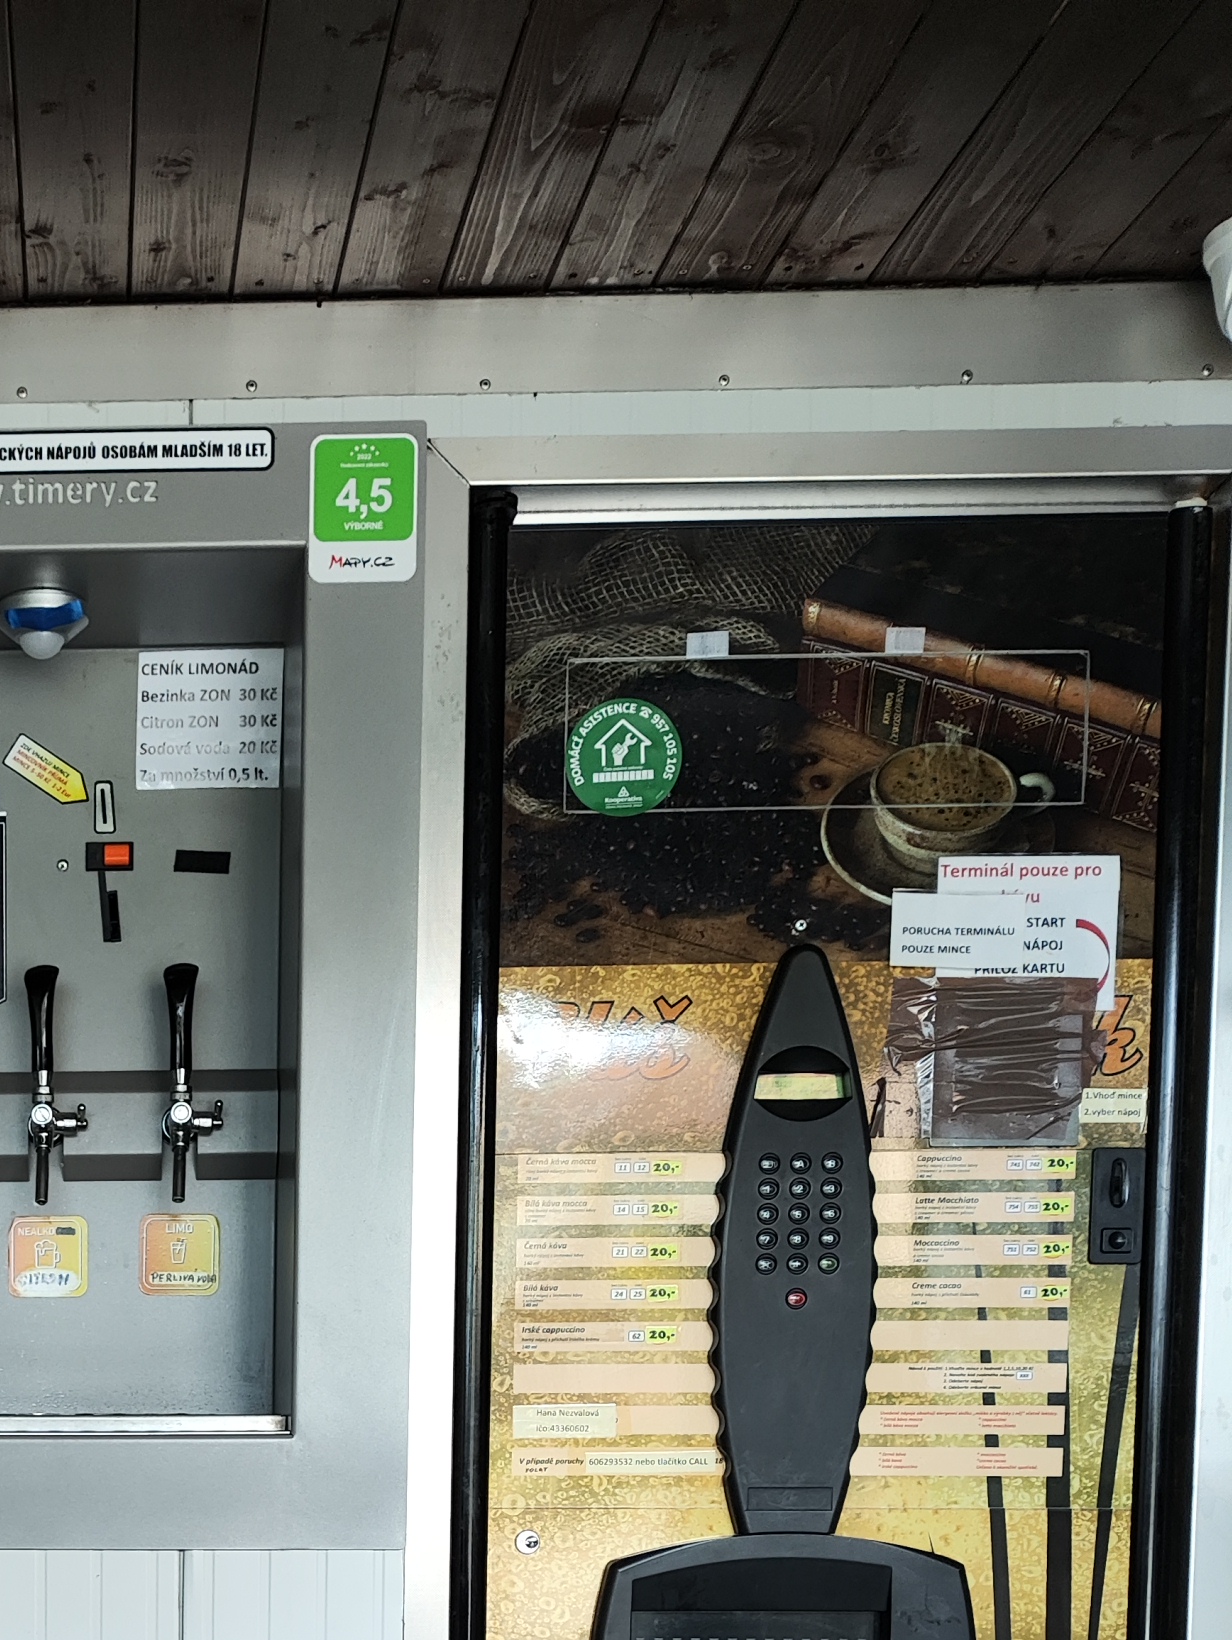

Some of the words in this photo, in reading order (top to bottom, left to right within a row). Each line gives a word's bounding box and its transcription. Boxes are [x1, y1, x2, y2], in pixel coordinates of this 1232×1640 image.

[46, 441, 96, 460] NÁPOJŮ
[101, 442, 158, 459] OSOBÁM
[161, 440, 223, 458] MLADŠÍM
[228, 443, 241, 457] 18
[246, 442, 268, 457] LET.
[335, 477, 393, 519] 4,5
[344, 520, 384, 531] VÝBORNÉ
[141, 660, 184, 676] CENÍK
[188, 658, 259, 675] LIMONÁD
[141, 689, 195, 702] Bezinka
[200, 689, 231, 702] ZON
[239, 688, 256, 701] 30
[261, 687, 278, 701] Kč
[141, 716, 184, 729] Citron
[188, 715, 219, 728] ZON
[239, 715, 256, 727] 30
[261, 714, 278, 727] Kč
[578, 702, 638, 737] ASISTENCE
[650, 714, 671, 733] 957
[140, 741, 191, 756] Sodová
[239, 741, 256, 754] 20
[261, 740, 278, 754] Kč
[663, 733, 677, 756] 105
[568, 735, 585, 787] DOMÁCÍ
[663, 757, 677, 780] 105
[140, 769, 156, 782] Za
[161, 768, 224, 782] množství
[228, 768, 250, 783] 0,5
[254, 767, 269, 781] lt.
[940, 863, 1015, 879] Terminál
[1019, 865, 1069, 880] pouze
[1074, 865, 1102, 880] pro
[1026, 916, 1066, 928] START
[902, 926, 952, 936] PORUCHA
[954, 925, 1015, 936] TERMINÁLU
[901, 945, 935, 954] POUZE
[937, 945, 971, 954] MINCE
[1023, 939, 1063, 951] NÁPOJ
[1022, 962, 1065, 974] KARTU
[1118, 1092, 1143, 1100] mince
[1118, 1108, 1141, 1118] nápoj
[526, 1157, 549, 1165] Černá
[1048, 1158, 1074, 1169] 20,-
[653, 1163, 679, 1173] 20,-
[651, 1204, 678, 1214] 20,-
[1043, 1202, 1069, 1212] 20,-
[18, 1227, 56, 1236] NEALKO
[166, 1223, 194, 1234] LIMO
[524, 1241, 547, 1249] Černá
[1043, 1244, 1069, 1254] 20,-
[650, 1247, 676, 1258] 20,-
[540, 1284, 559, 1292] káva
[649, 1288, 675, 1299] 20,-
[1041, 1287, 1067, 1297] 20,-
[649, 1330, 675, 1341] 20,-
[537, 1409, 557, 1417] Hana
[559, 1408, 600, 1417] Nezvalová
[555, 1458, 585, 1466] poruchy
